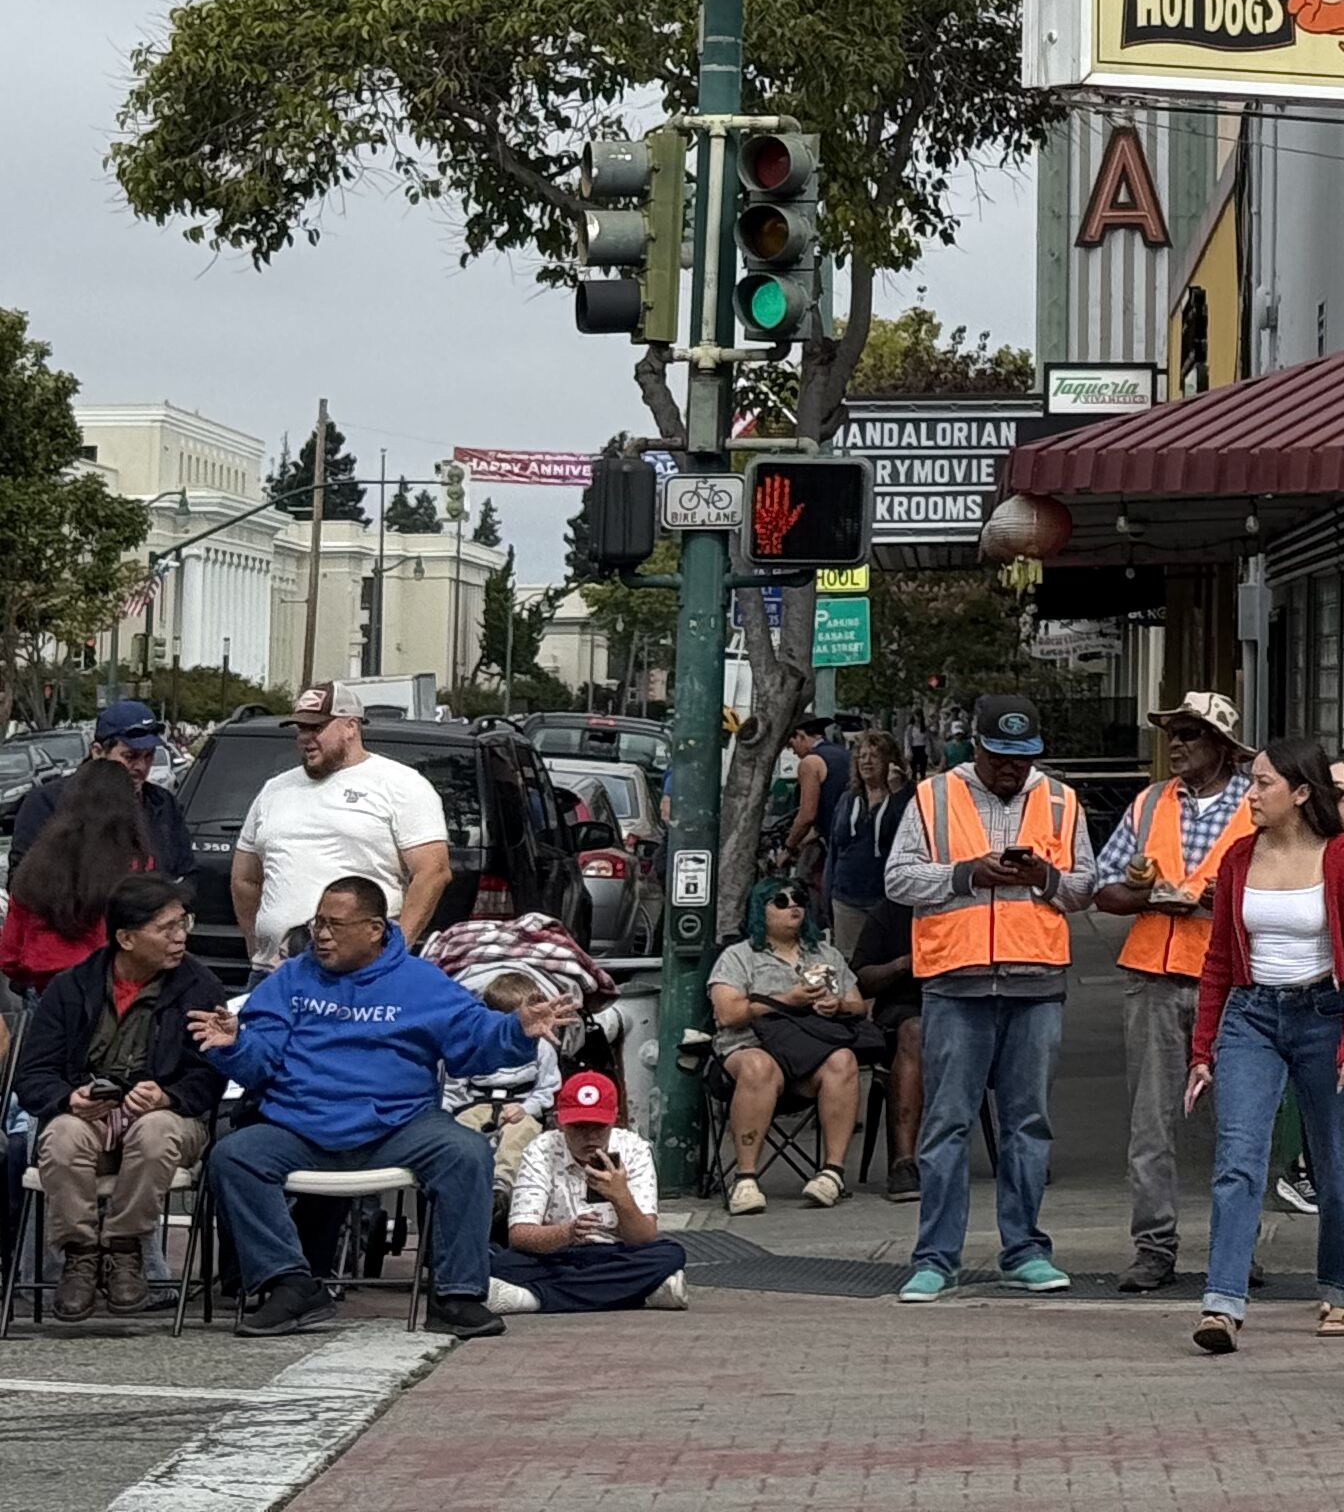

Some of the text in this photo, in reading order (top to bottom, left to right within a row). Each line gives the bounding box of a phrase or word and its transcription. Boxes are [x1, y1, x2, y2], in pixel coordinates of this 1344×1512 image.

[671, 511, 737, 523] BIKE LANE
[202, 842, 231, 852] 350
